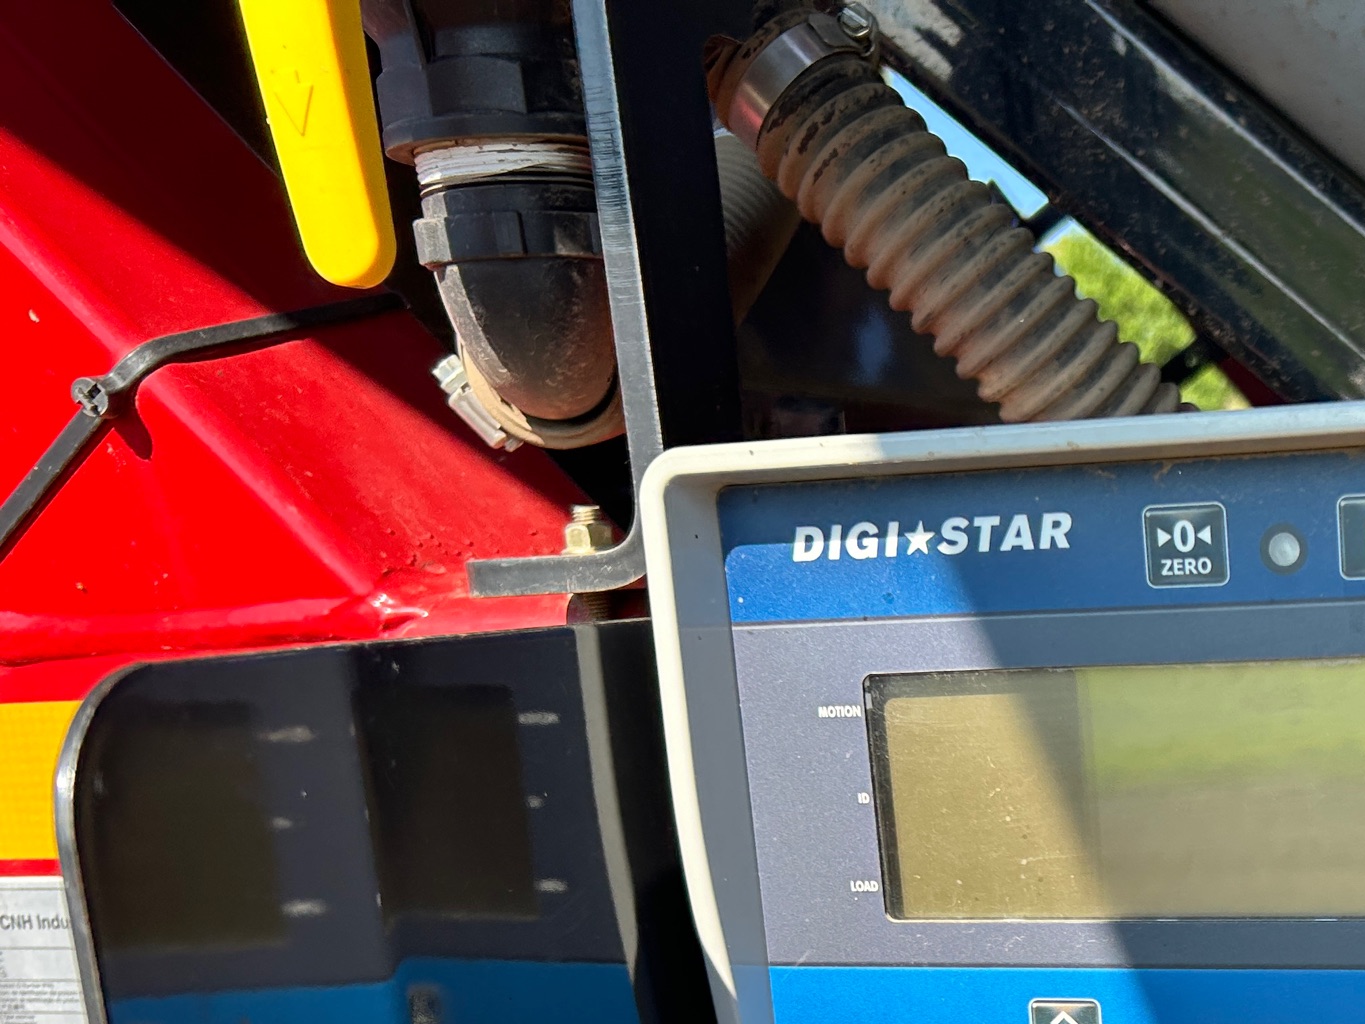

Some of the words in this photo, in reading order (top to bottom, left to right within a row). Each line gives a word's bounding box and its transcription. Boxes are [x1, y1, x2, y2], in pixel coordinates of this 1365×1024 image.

[1160, 557, 1212, 576] ZERO
[817, 704, 862, 718] MOTION
[857, 792, 871, 804] ID
[849, 879, 879, 892] LOAD
[0, 914, 33, 930] CNH
